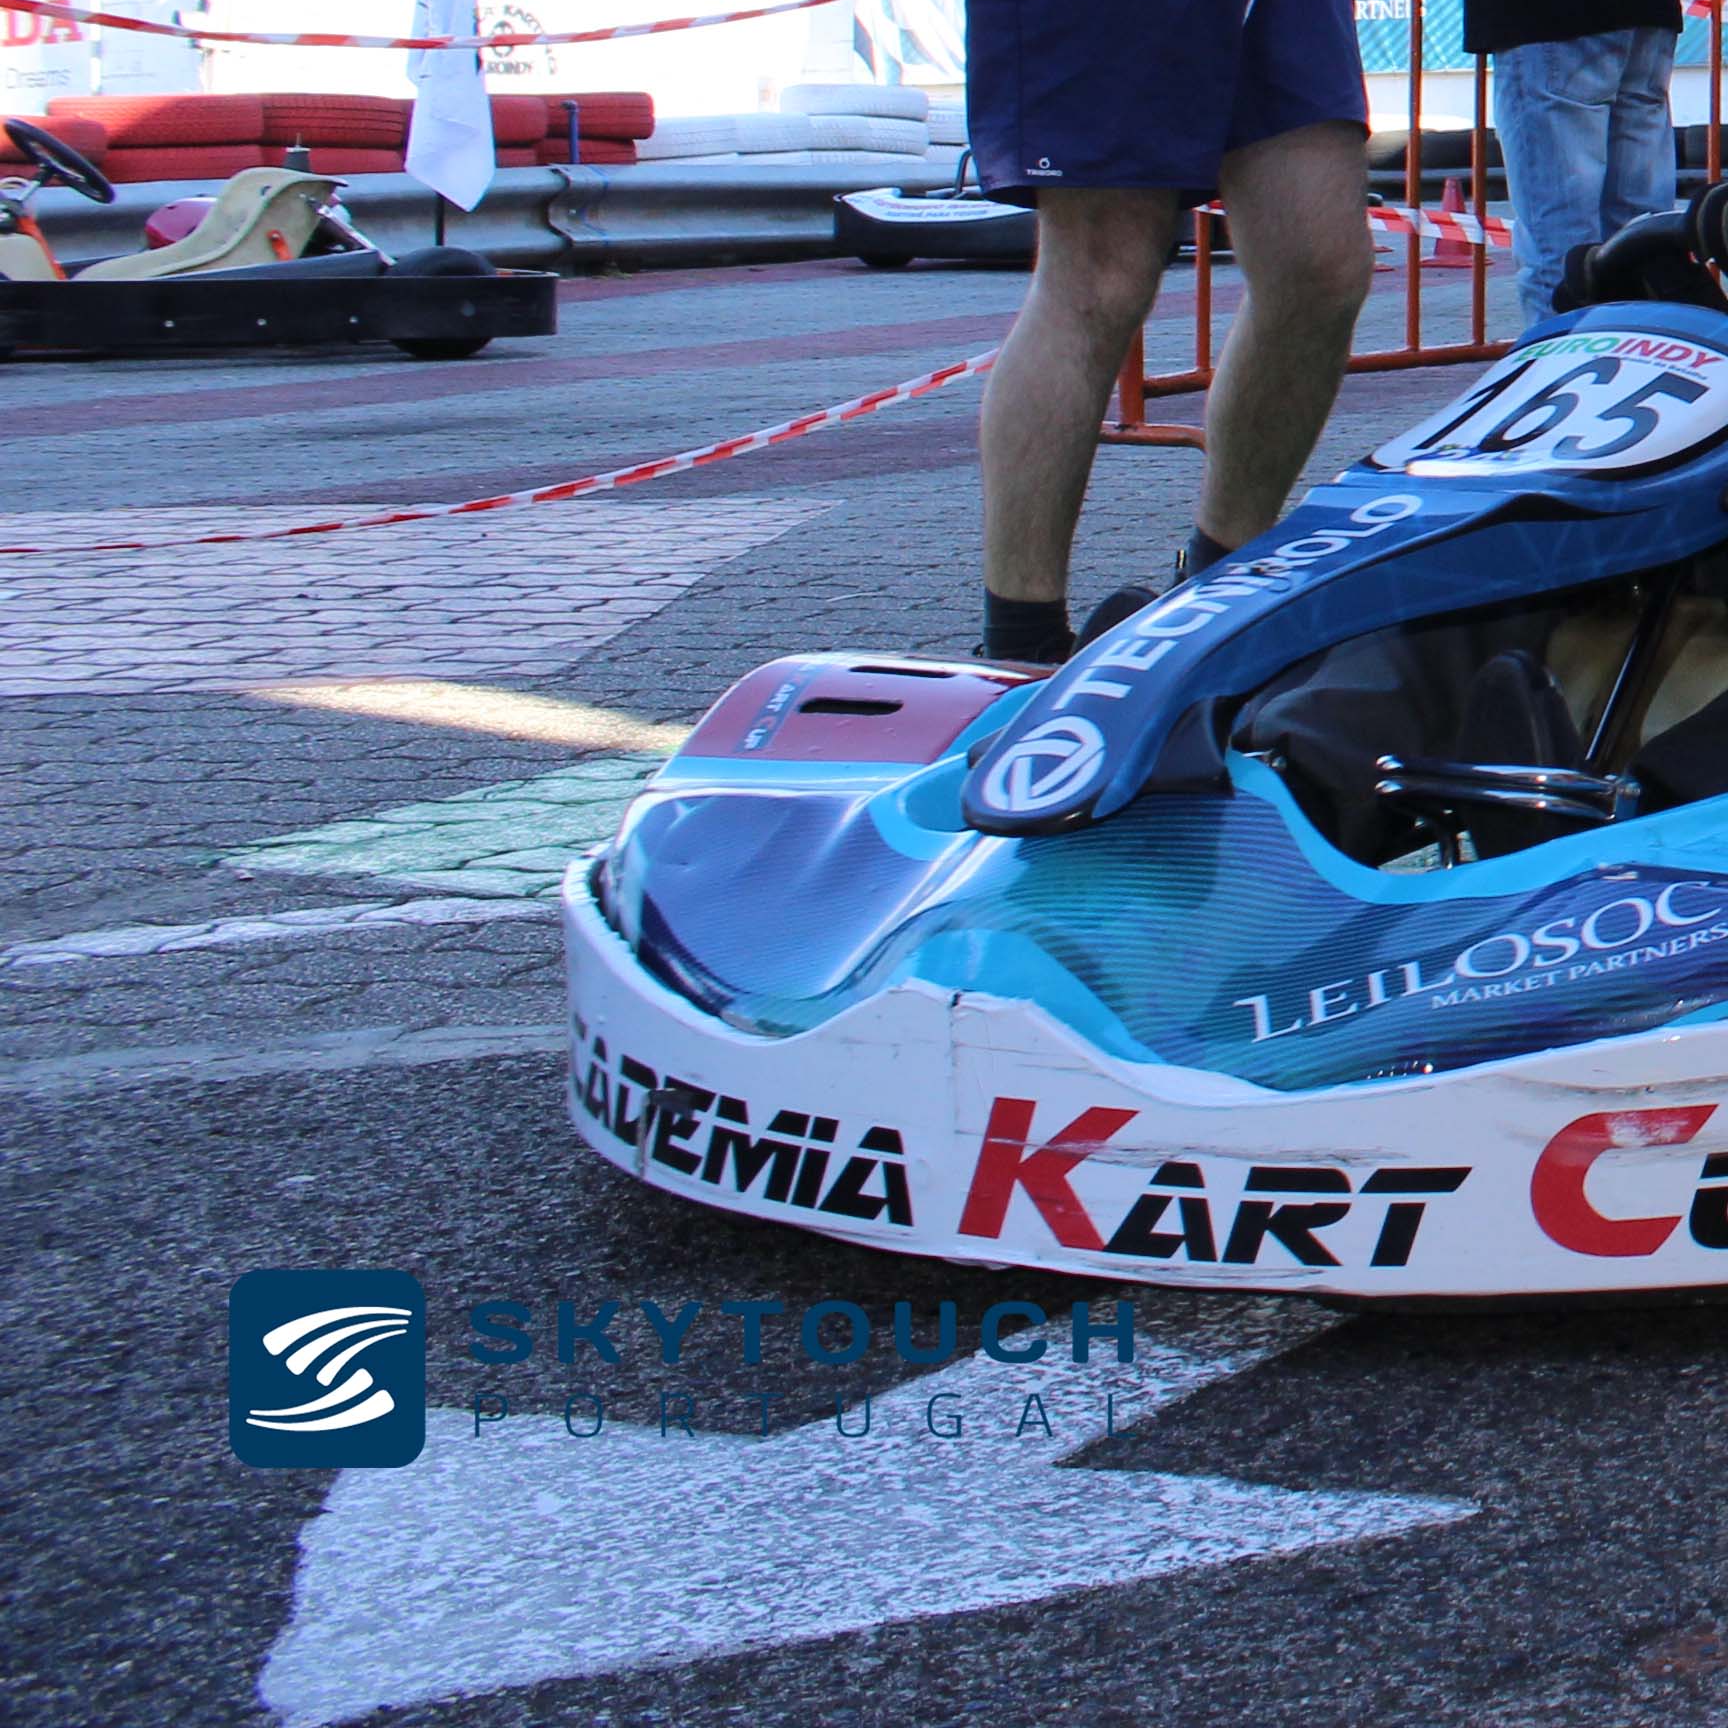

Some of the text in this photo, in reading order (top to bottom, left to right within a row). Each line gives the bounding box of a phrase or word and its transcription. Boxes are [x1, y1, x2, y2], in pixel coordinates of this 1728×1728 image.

[1412, 356, 1711, 461] 165
[1514, 336, 1725, 370] EUROINDY
[1050, 493, 1424, 711] TECNIROLO
[1233, 881, 1722, 1044] LEILOSOC
[1431, 970, 1561, 1010] MARKET
[957, 1096, 1473, 1268] KART
